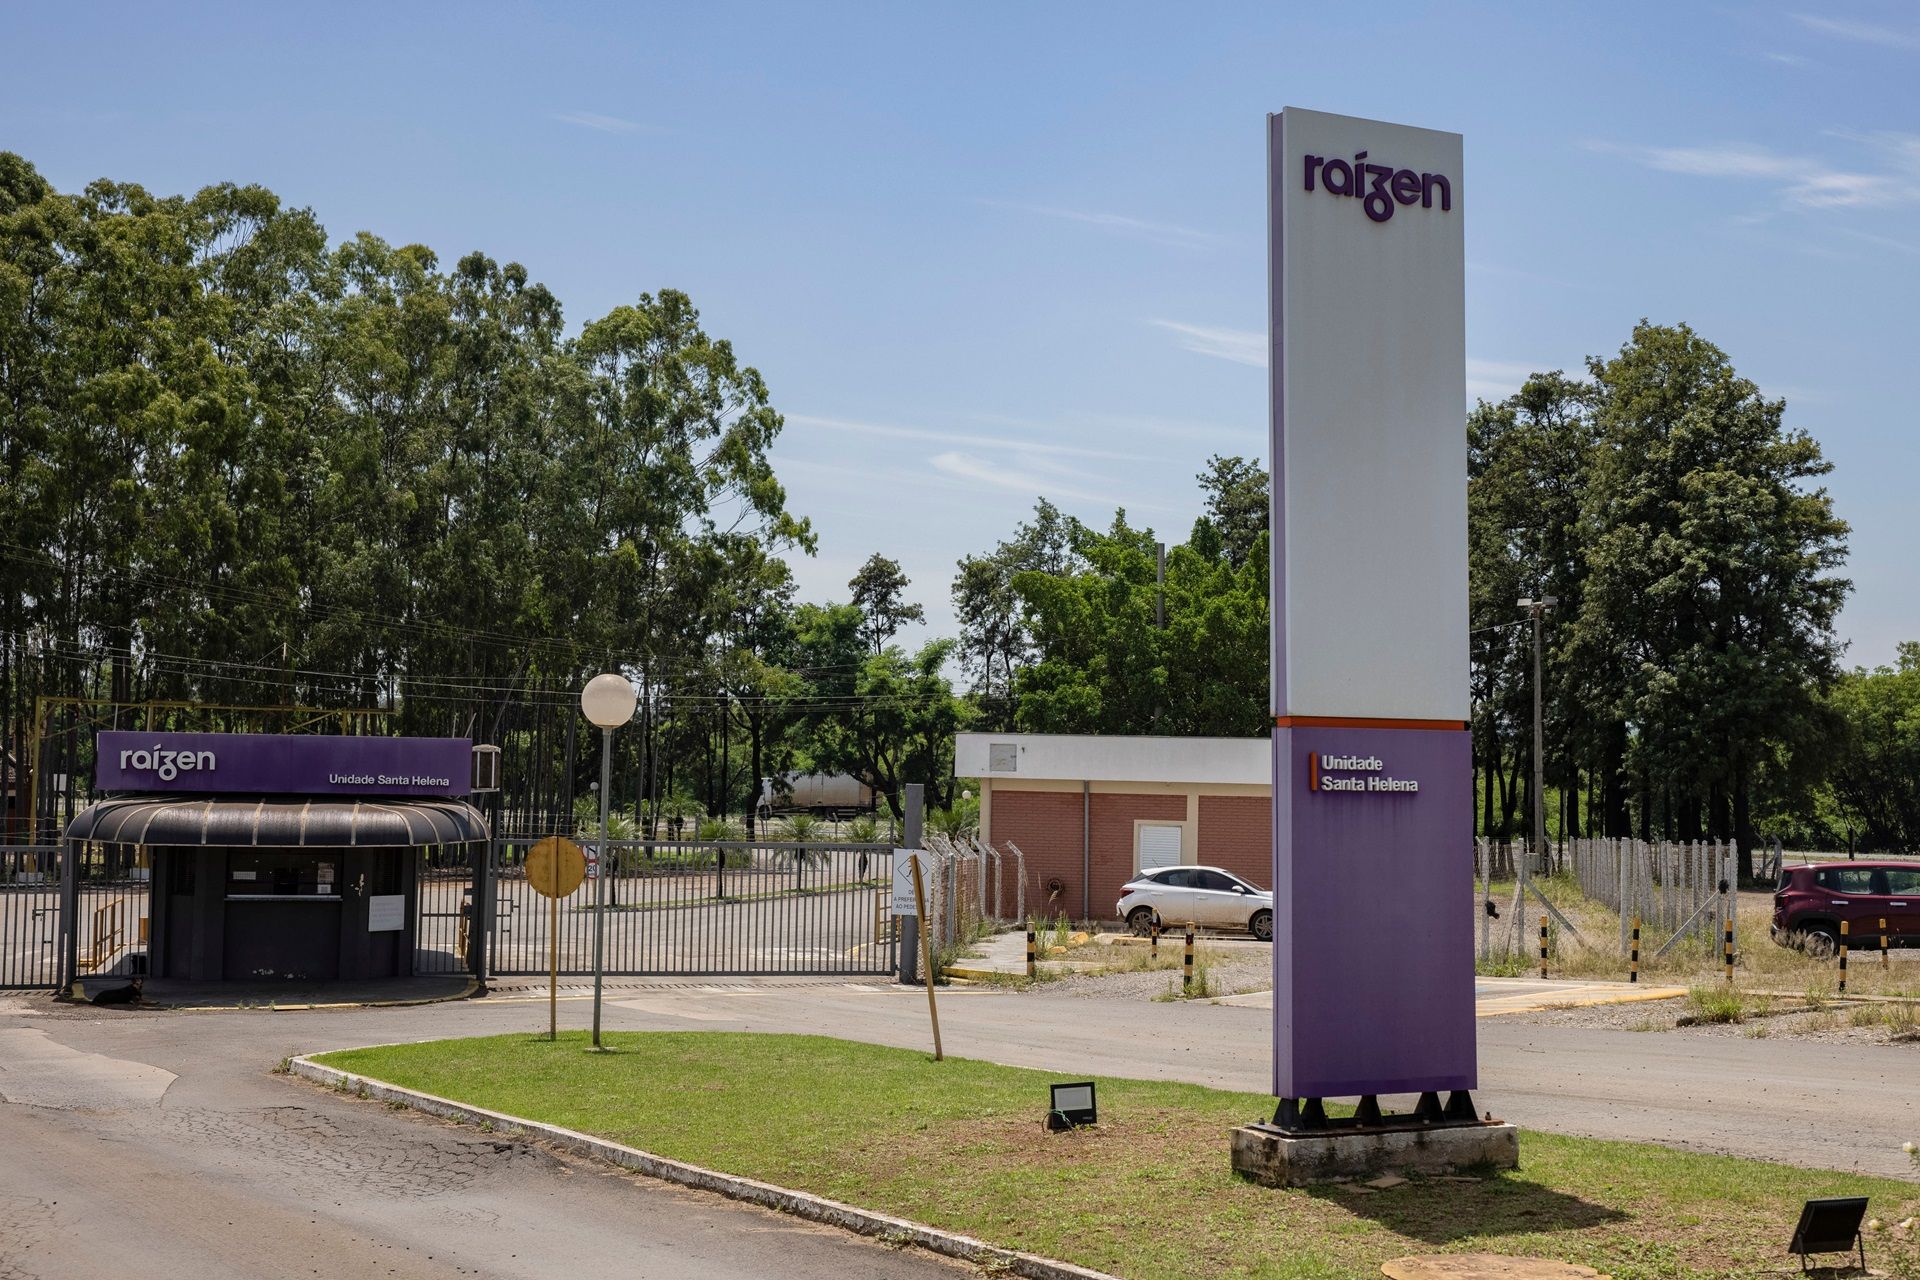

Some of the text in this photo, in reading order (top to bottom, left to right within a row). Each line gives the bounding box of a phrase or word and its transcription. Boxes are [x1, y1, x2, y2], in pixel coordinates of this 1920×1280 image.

[1304, 150, 1451, 222] raízen
[120, 743, 216, 781] raízen
[1321, 755, 1383, 771] Unidade
[329, 773, 450, 786] Unidade Santa Helena
[1321, 775, 1418, 792] Santa Helena
